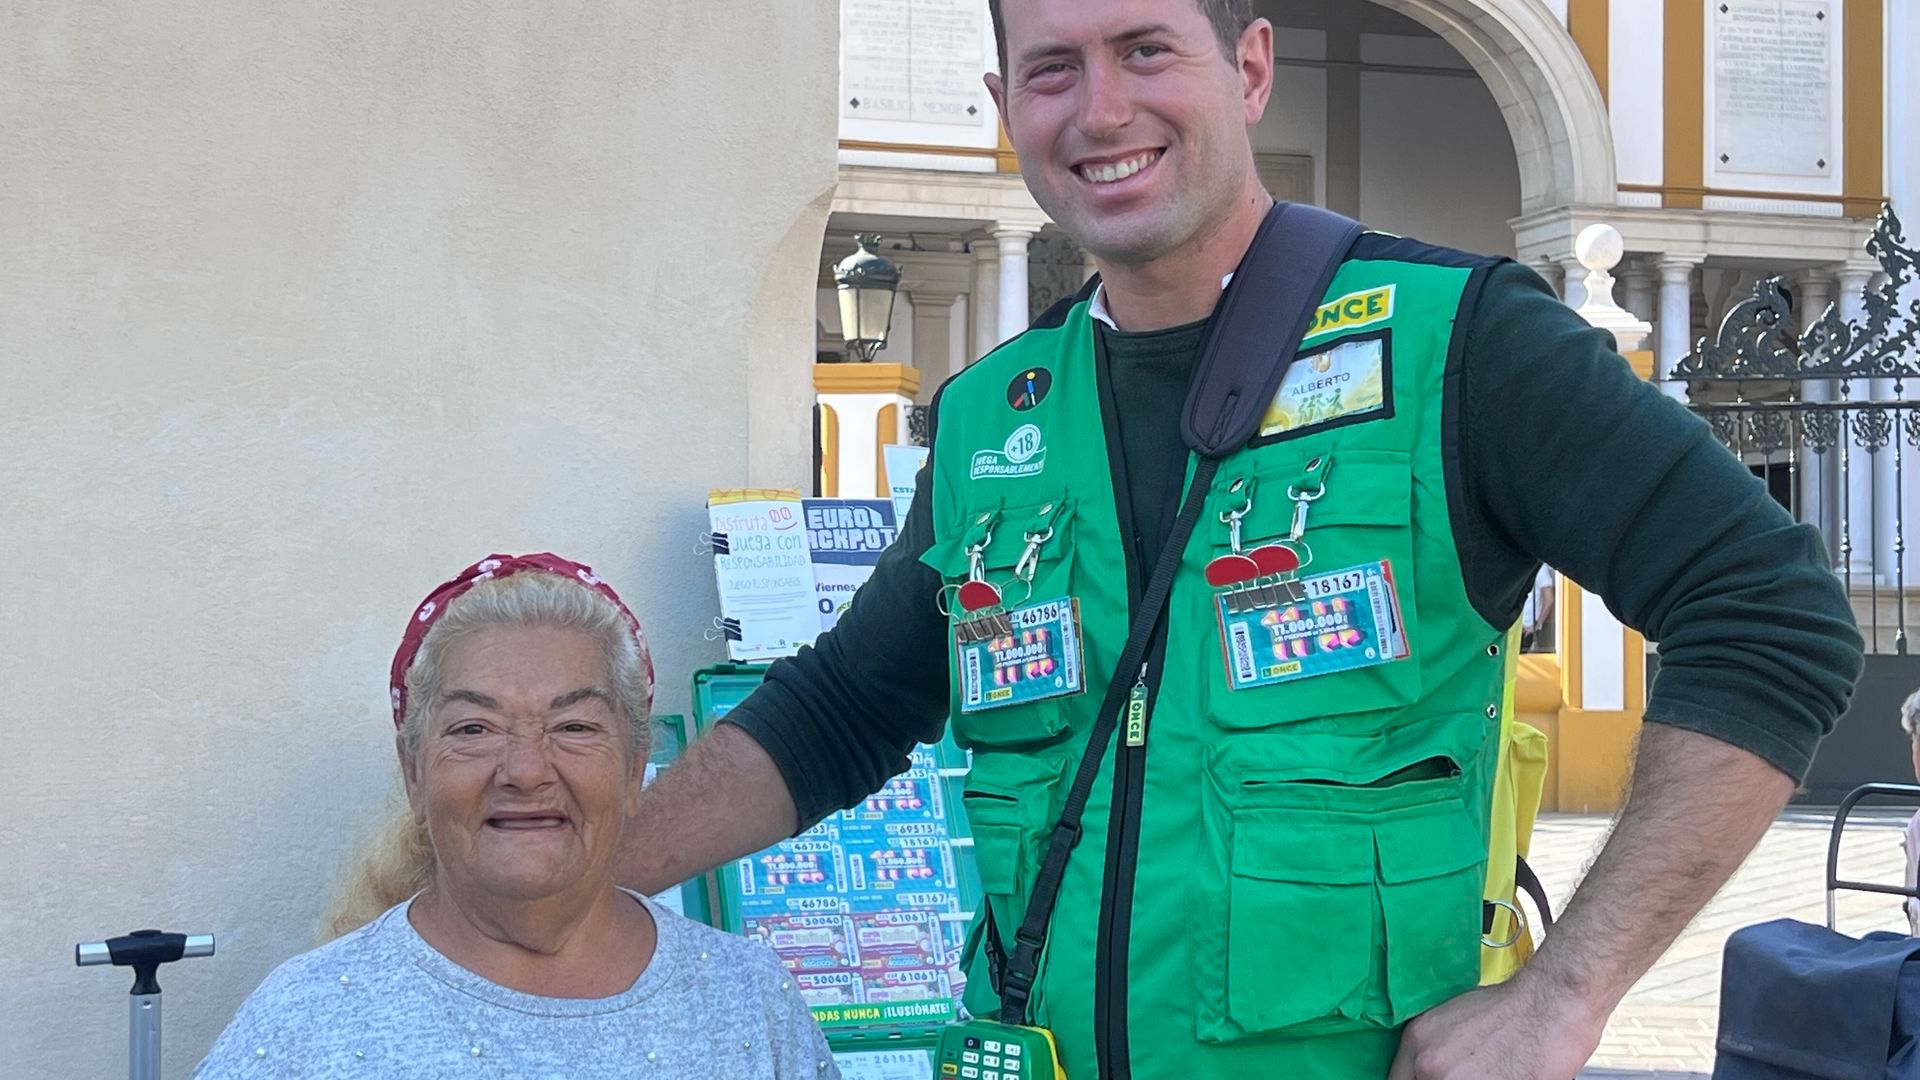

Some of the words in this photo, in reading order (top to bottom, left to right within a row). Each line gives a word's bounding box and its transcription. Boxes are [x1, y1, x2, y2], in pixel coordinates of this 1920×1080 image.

[1291, 372, 1351, 397] ALBERTO
[1011, 432, 1033, 455] +18
[807, 508, 871, 529] EURO
[808, 528, 895, 550] ACKPOT
[720, 554, 807, 570] RESPONSABILIDAD
[1312, 573, 1361, 595] 18167
[1022, 605, 1057, 625] 46786
[1273, 662, 1299, 674] ONCE
[1130, 702, 1142, 739] ONCE
[899, 824, 933, 834] 69515
[794, 842, 829, 851] 46786
[903, 838, 936, 847] 18167
[802, 898, 837, 908] 46786
[912, 893, 945, 904] 18167
[805, 916, 840, 926] 50040
[891, 913, 925, 922] 61061
[813, 975, 849, 985] 50040
[900, 971, 934, 982] 61061
[812, 1010, 841, 1022] NDAS
[843, 1008, 880, 1020] NUNCA
[884, 1002, 950, 1018] ¡ILUSIÓNATE!
